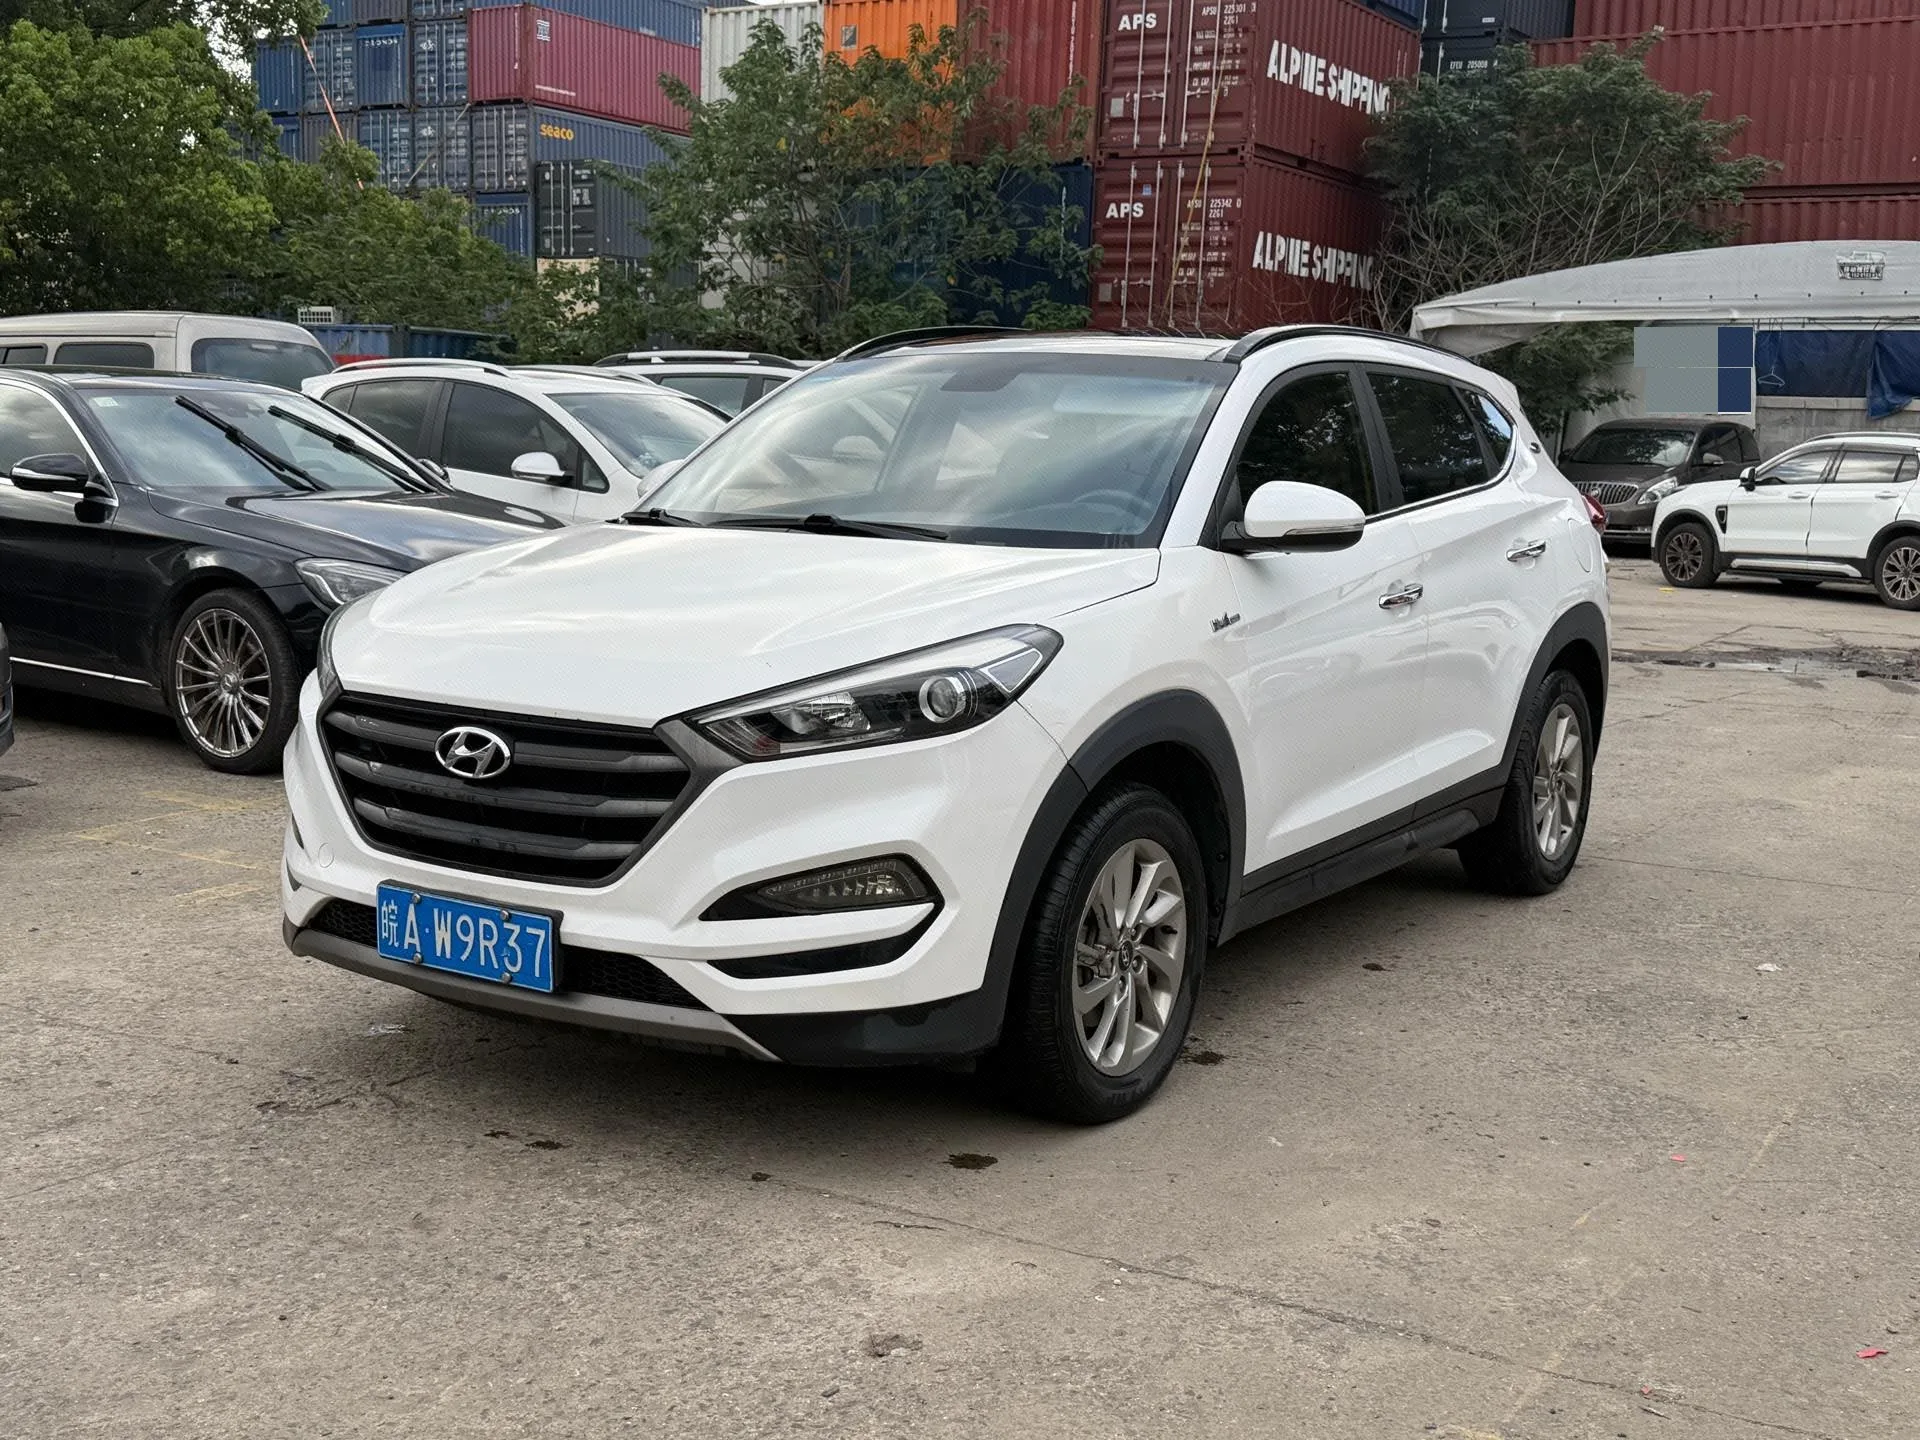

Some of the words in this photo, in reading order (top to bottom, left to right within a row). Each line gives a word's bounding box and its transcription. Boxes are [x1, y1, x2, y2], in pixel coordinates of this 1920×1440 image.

[1118, 13, 1157, 31] APS
[540, 123, 575, 141] seaco
[1106, 202, 1144, 218] APS
